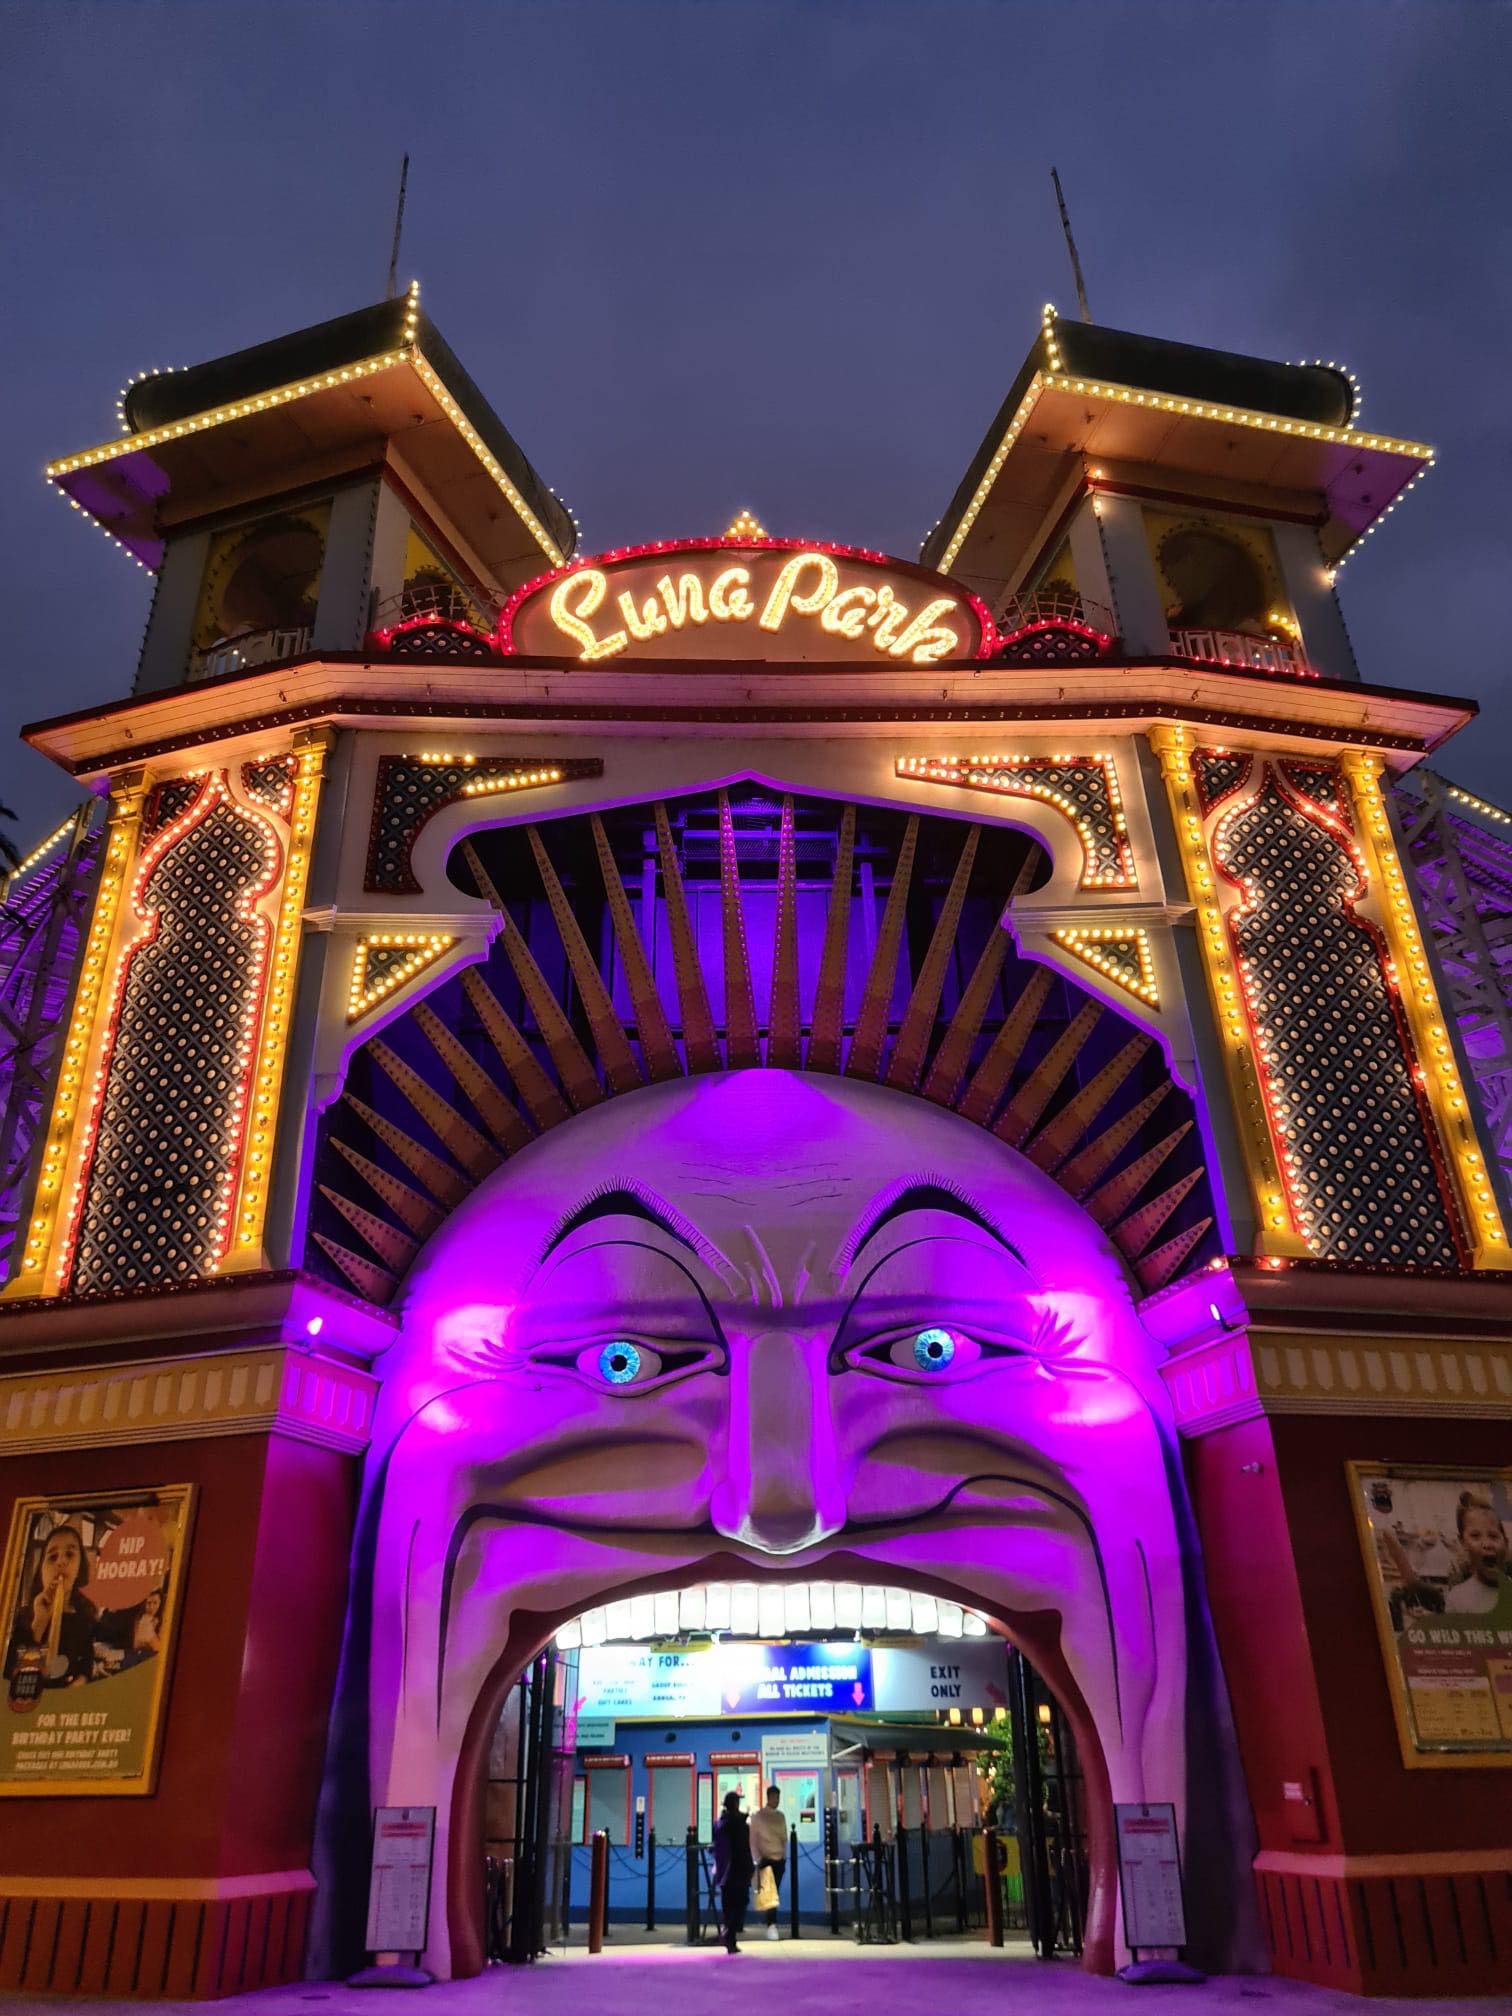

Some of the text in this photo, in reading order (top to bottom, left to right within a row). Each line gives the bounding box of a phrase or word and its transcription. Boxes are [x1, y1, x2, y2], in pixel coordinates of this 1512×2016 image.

[550, 552, 958, 662] Luna Park
[119, 1536, 145, 1554] HIP
[97, 1558, 165, 1579] HOORAY!
[1408, 1629, 1426, 1644] GO
[1429, 1629, 1461, 1644] WILD
[1463, 1630, 1494, 1645] THIS
[930, 1666, 960, 1679] EXIT
[757, 1683, 832, 1698] ALL TICKETS
[931, 1685, 961, 1698] ONLY
[37, 1713, 109, 1728] FOR THE BEST
[11, 1728, 132, 1745] BIRTHDAY PARTY EVER!
